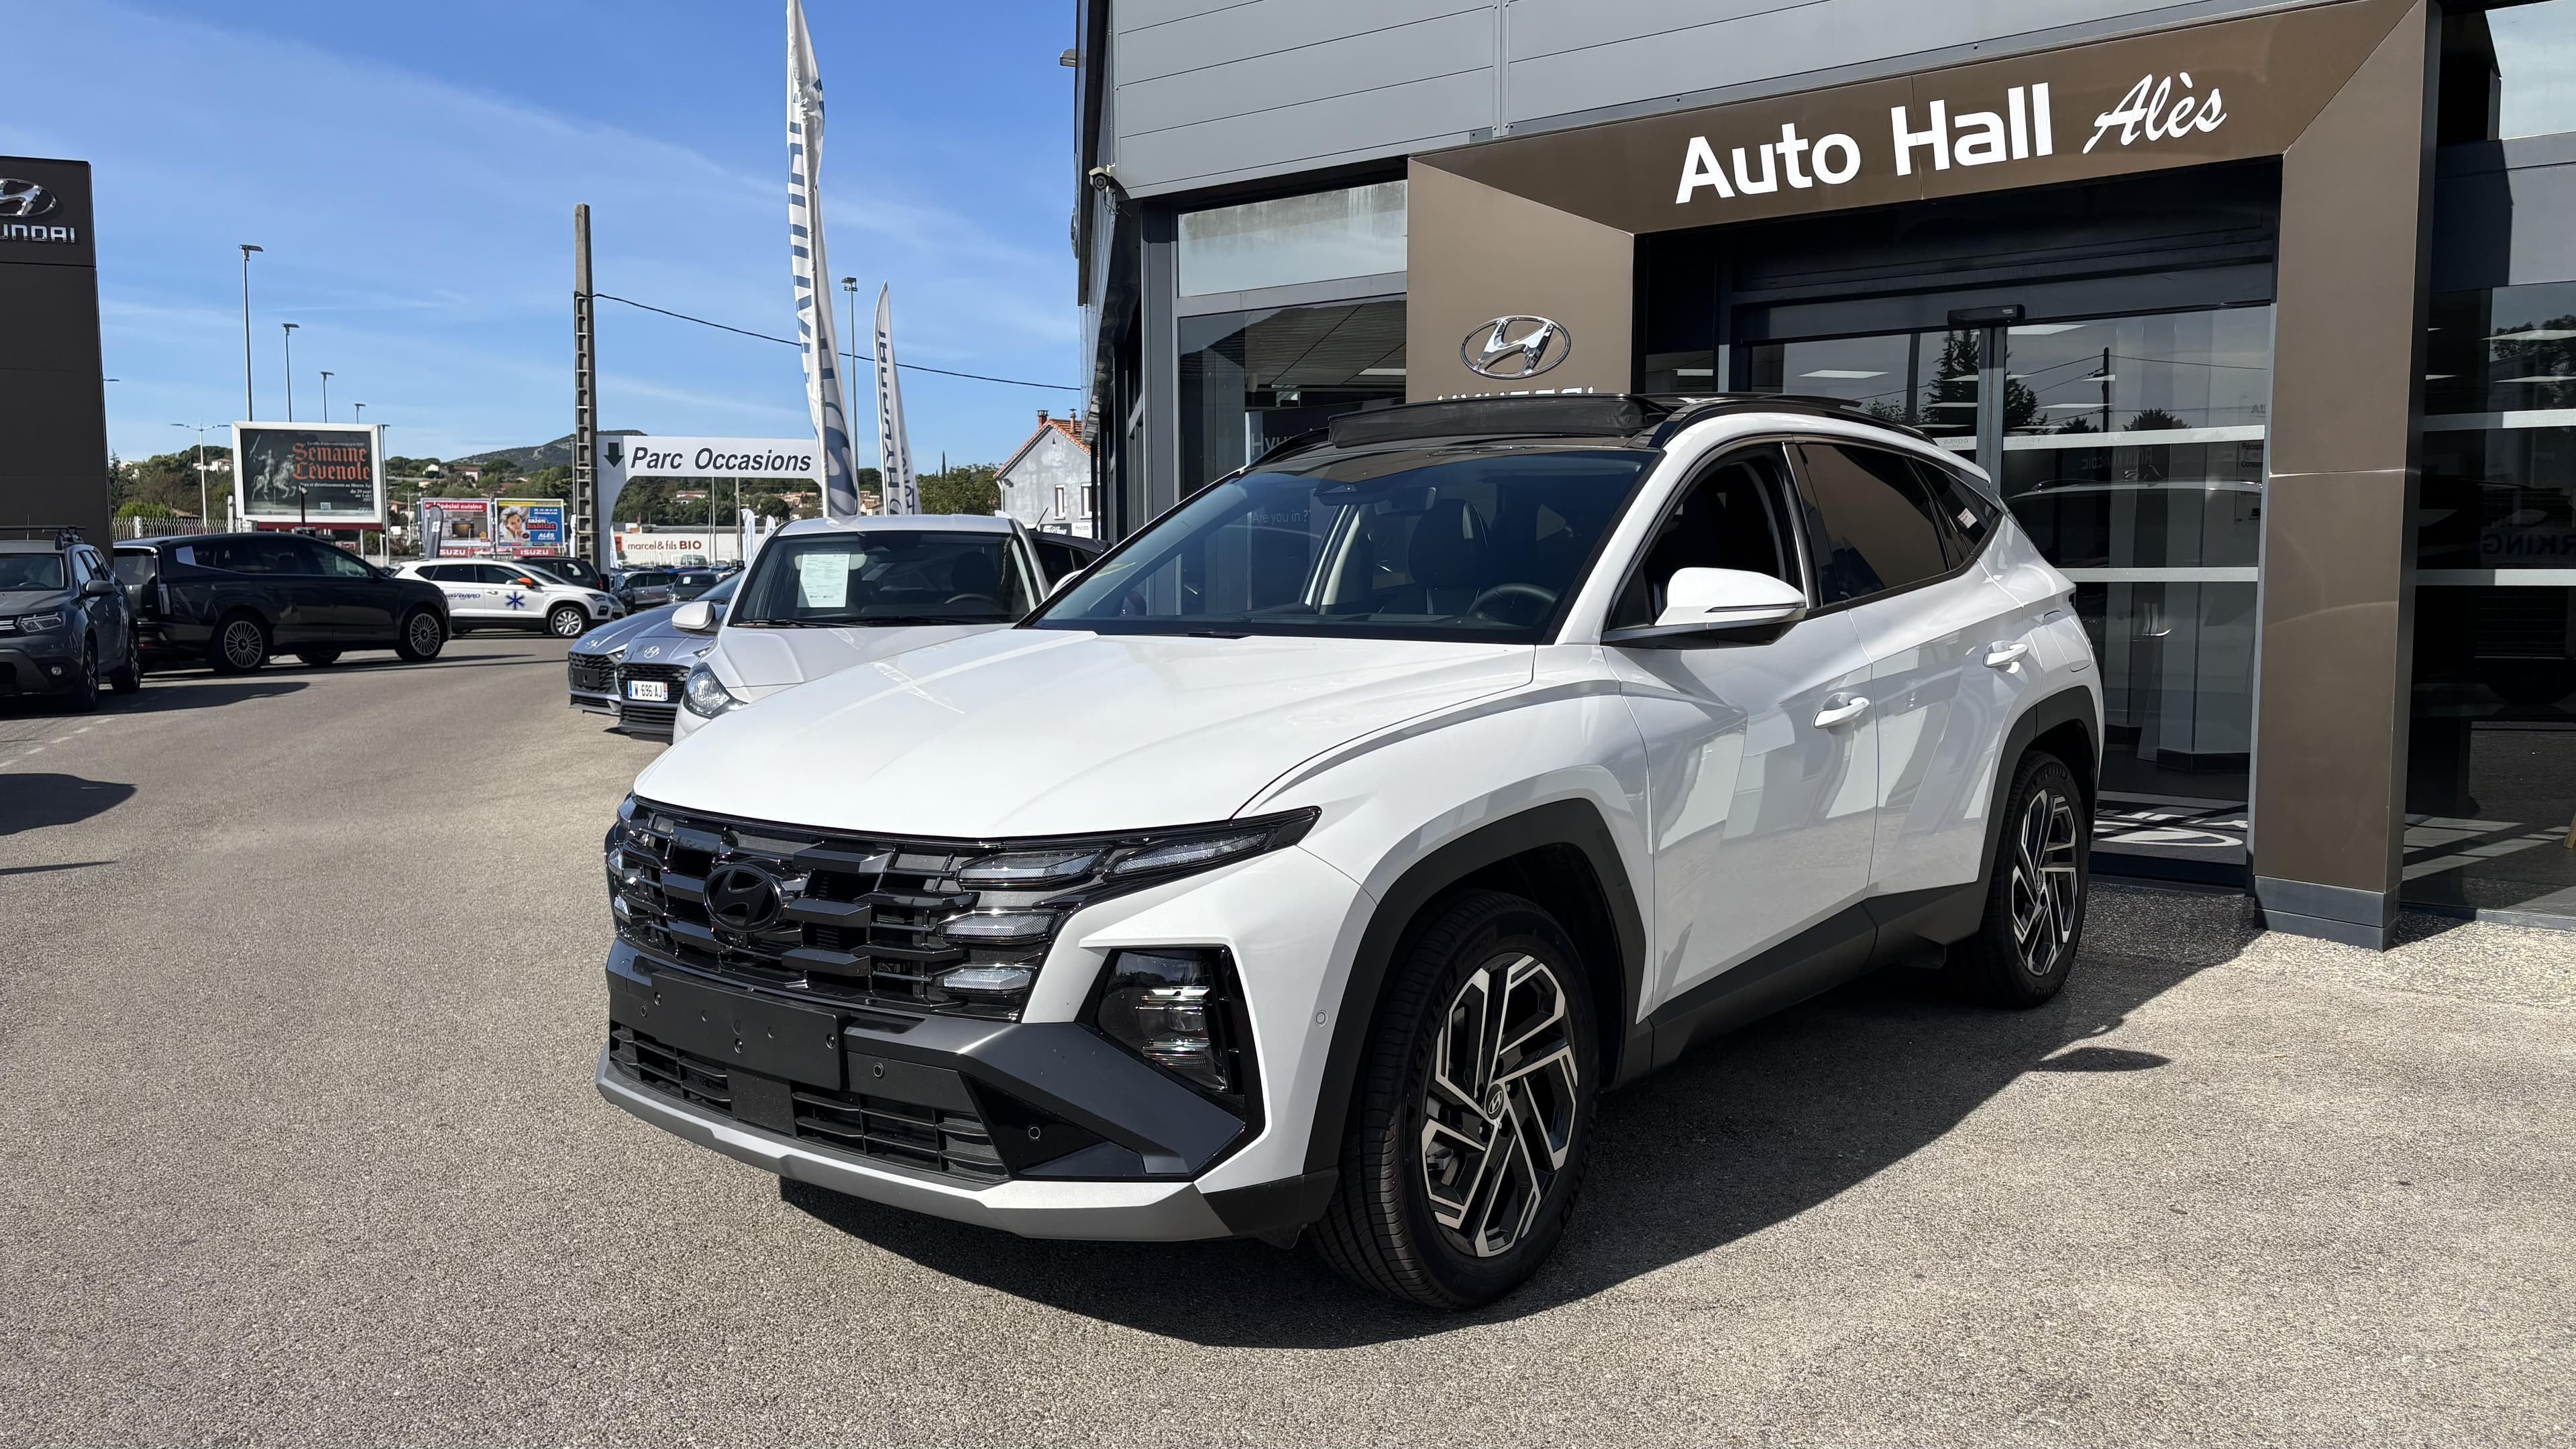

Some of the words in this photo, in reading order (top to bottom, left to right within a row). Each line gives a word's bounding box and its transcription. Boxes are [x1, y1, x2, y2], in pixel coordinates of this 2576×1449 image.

[1675, 121, 1861, 205] Auto
[1890, 82, 2053, 176] Hall
[2082, 71, 2227, 155] Alès
[0, 223, 75, 242] NDAI
[292, 443, 367, 462] Semaine
[631, 446, 683, 469] Parc
[694, 447, 812, 471] Occasions
[292, 462, 370, 480] Cévenole
[1252, 512, 1269, 523] Are
[1271, 514, 1289, 525] you
[1291, 510, 1300, 522] in
[627, 540, 657, 550] marcel
[657, 541, 664, 550] &
[665, 540, 677, 550] fils
[679, 541, 702, 550] BIO
